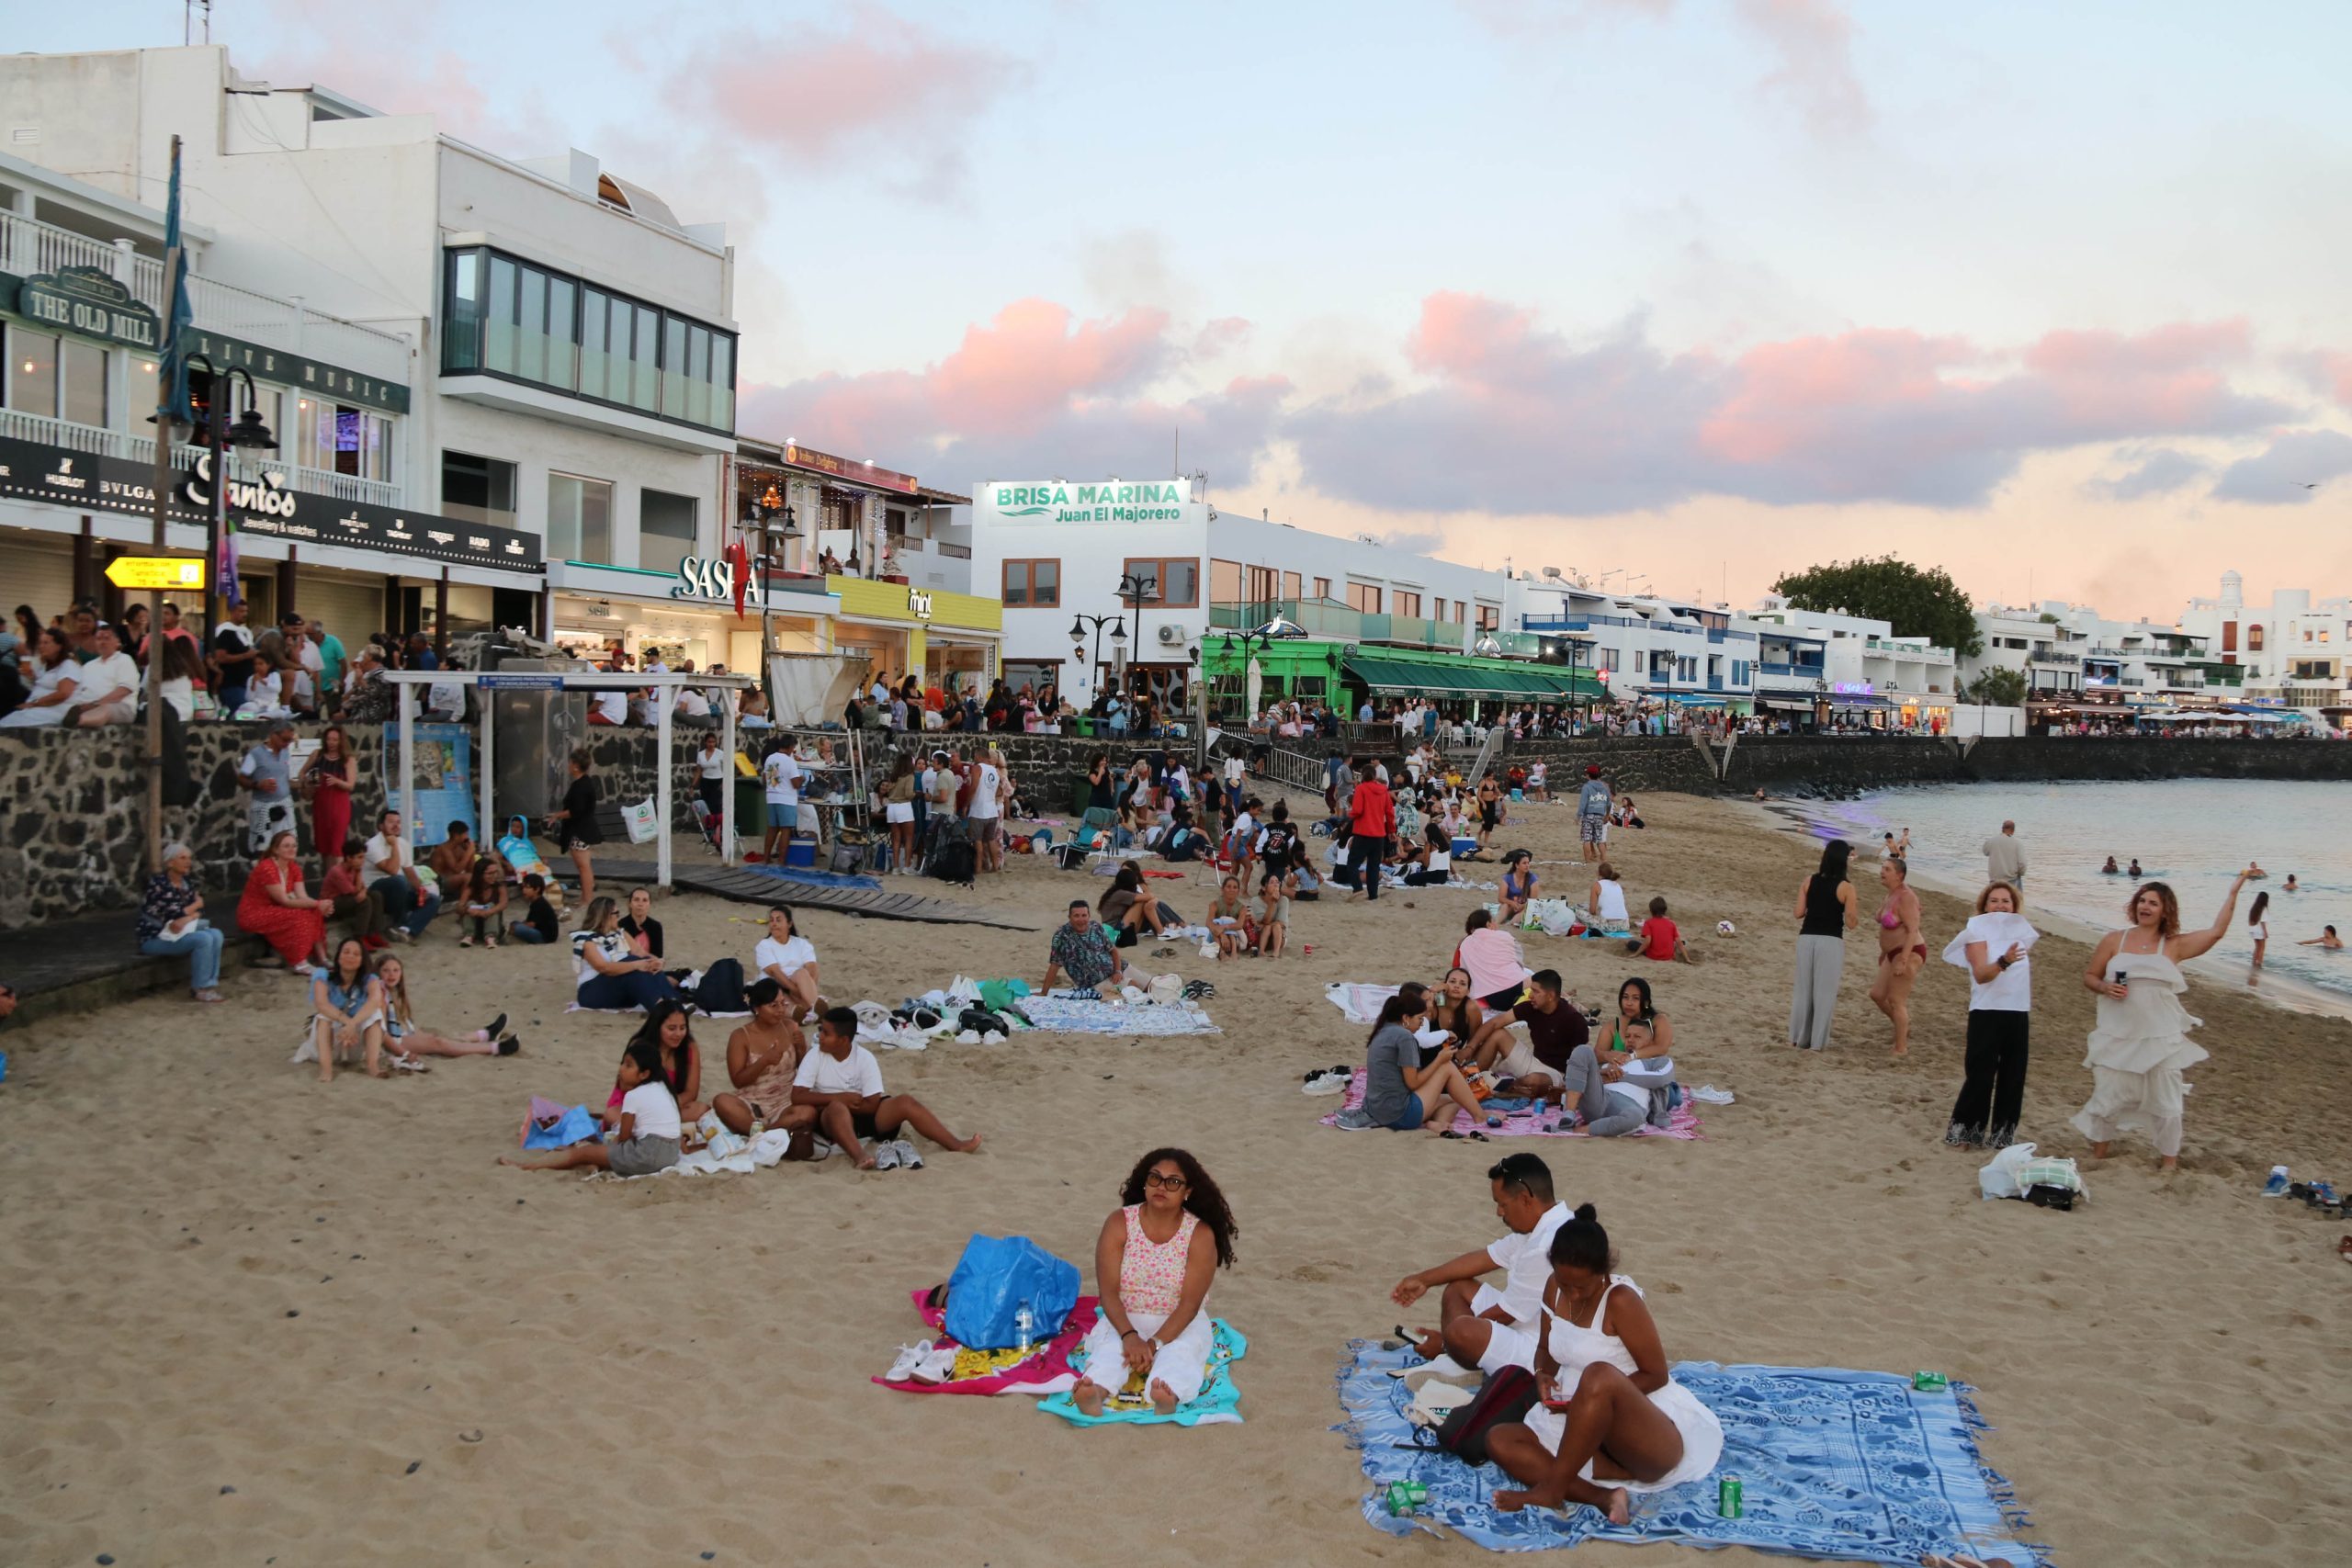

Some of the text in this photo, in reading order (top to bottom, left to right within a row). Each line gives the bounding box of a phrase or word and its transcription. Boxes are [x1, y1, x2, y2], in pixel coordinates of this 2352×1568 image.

[30, 290, 154, 345] THE OLD MILL
[201, 338, 388, 400] LIVE MUSIC
[99, 480, 175, 503] BVLGAI
[998, 484, 1180, 506] BRISA MARINA
[1055, 506, 1180, 524] Juan El Majorero
[242, 516, 318, 537] Jewellery & watches
[910, 592, 932, 613] mint
